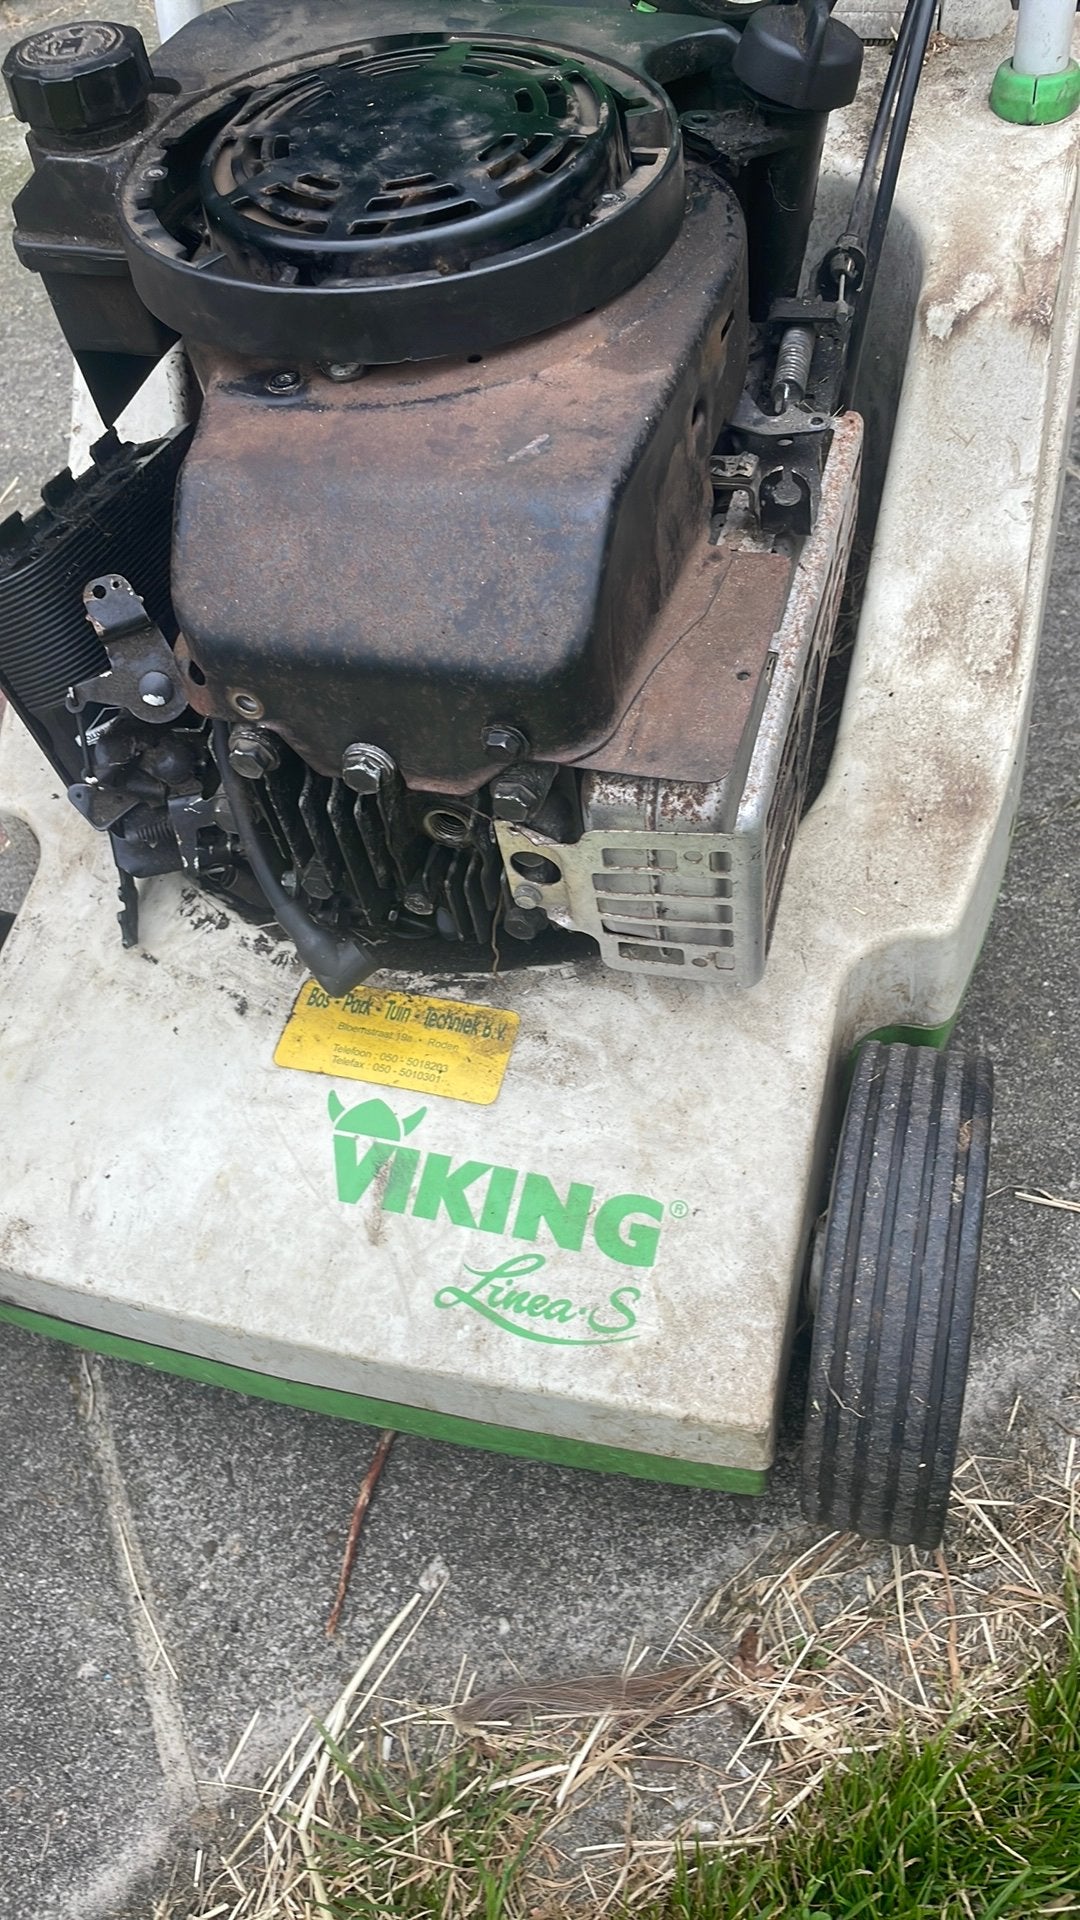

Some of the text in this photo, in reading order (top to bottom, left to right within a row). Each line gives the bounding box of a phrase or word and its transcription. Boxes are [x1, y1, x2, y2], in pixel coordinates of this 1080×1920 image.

[306, 987, 330, 1009] Bos
[384, 999, 411, 1022] Tuin
[423, 1006, 481, 1036] Techniek
[427, 1038, 460, 1052] Roden
[380, 1051, 399, 1063] 050
[372, 1062, 392, 1074] 050
[398, 1067, 441, 1083] 5010301
[333, 1134, 665, 1267] VIKING
